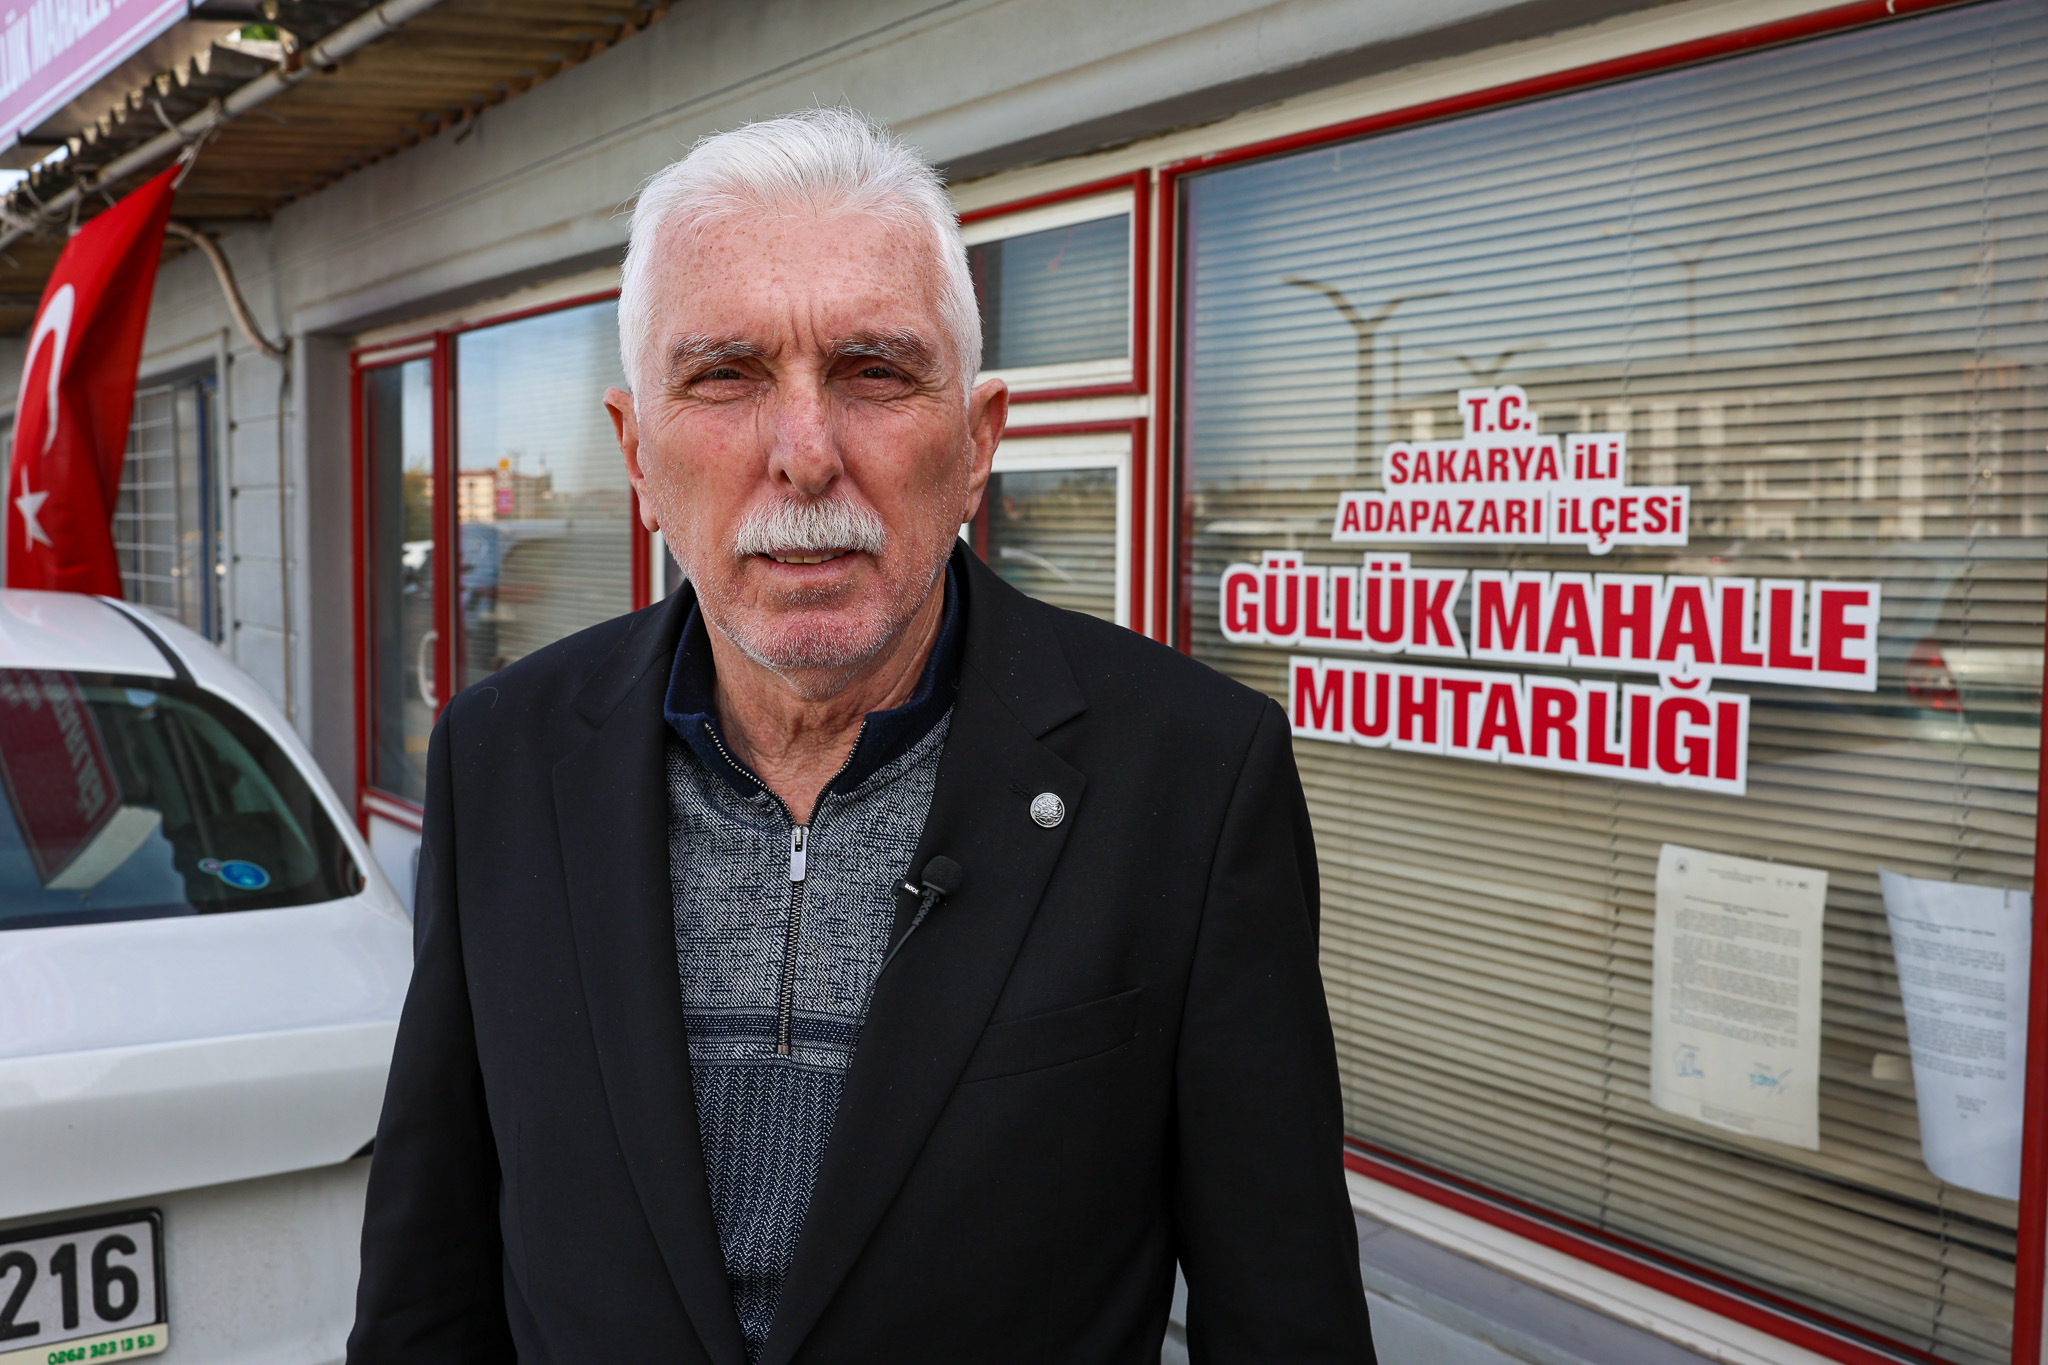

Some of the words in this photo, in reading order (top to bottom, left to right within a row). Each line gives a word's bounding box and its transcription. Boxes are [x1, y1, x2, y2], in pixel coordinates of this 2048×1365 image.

[1467, 395, 1531, 432] T.C.
[1390, 445, 1559, 485] SAKARYA
[1341, 498, 1542, 534] ADAPAZARI
[1225, 559, 1455, 648] GÜLLÜK
[1478, 580, 1870, 675] MAHALLE
[1294, 666, 1740, 781] MUHTARLIĞI
[0, 1233, 140, 1342] 216
[47, 1346, 86, 1365] 0262
[90, 1340, 117, 1358] 323
[120, 1337, 134, 1352] 13
[137, 1333, 156, 1349] 53
